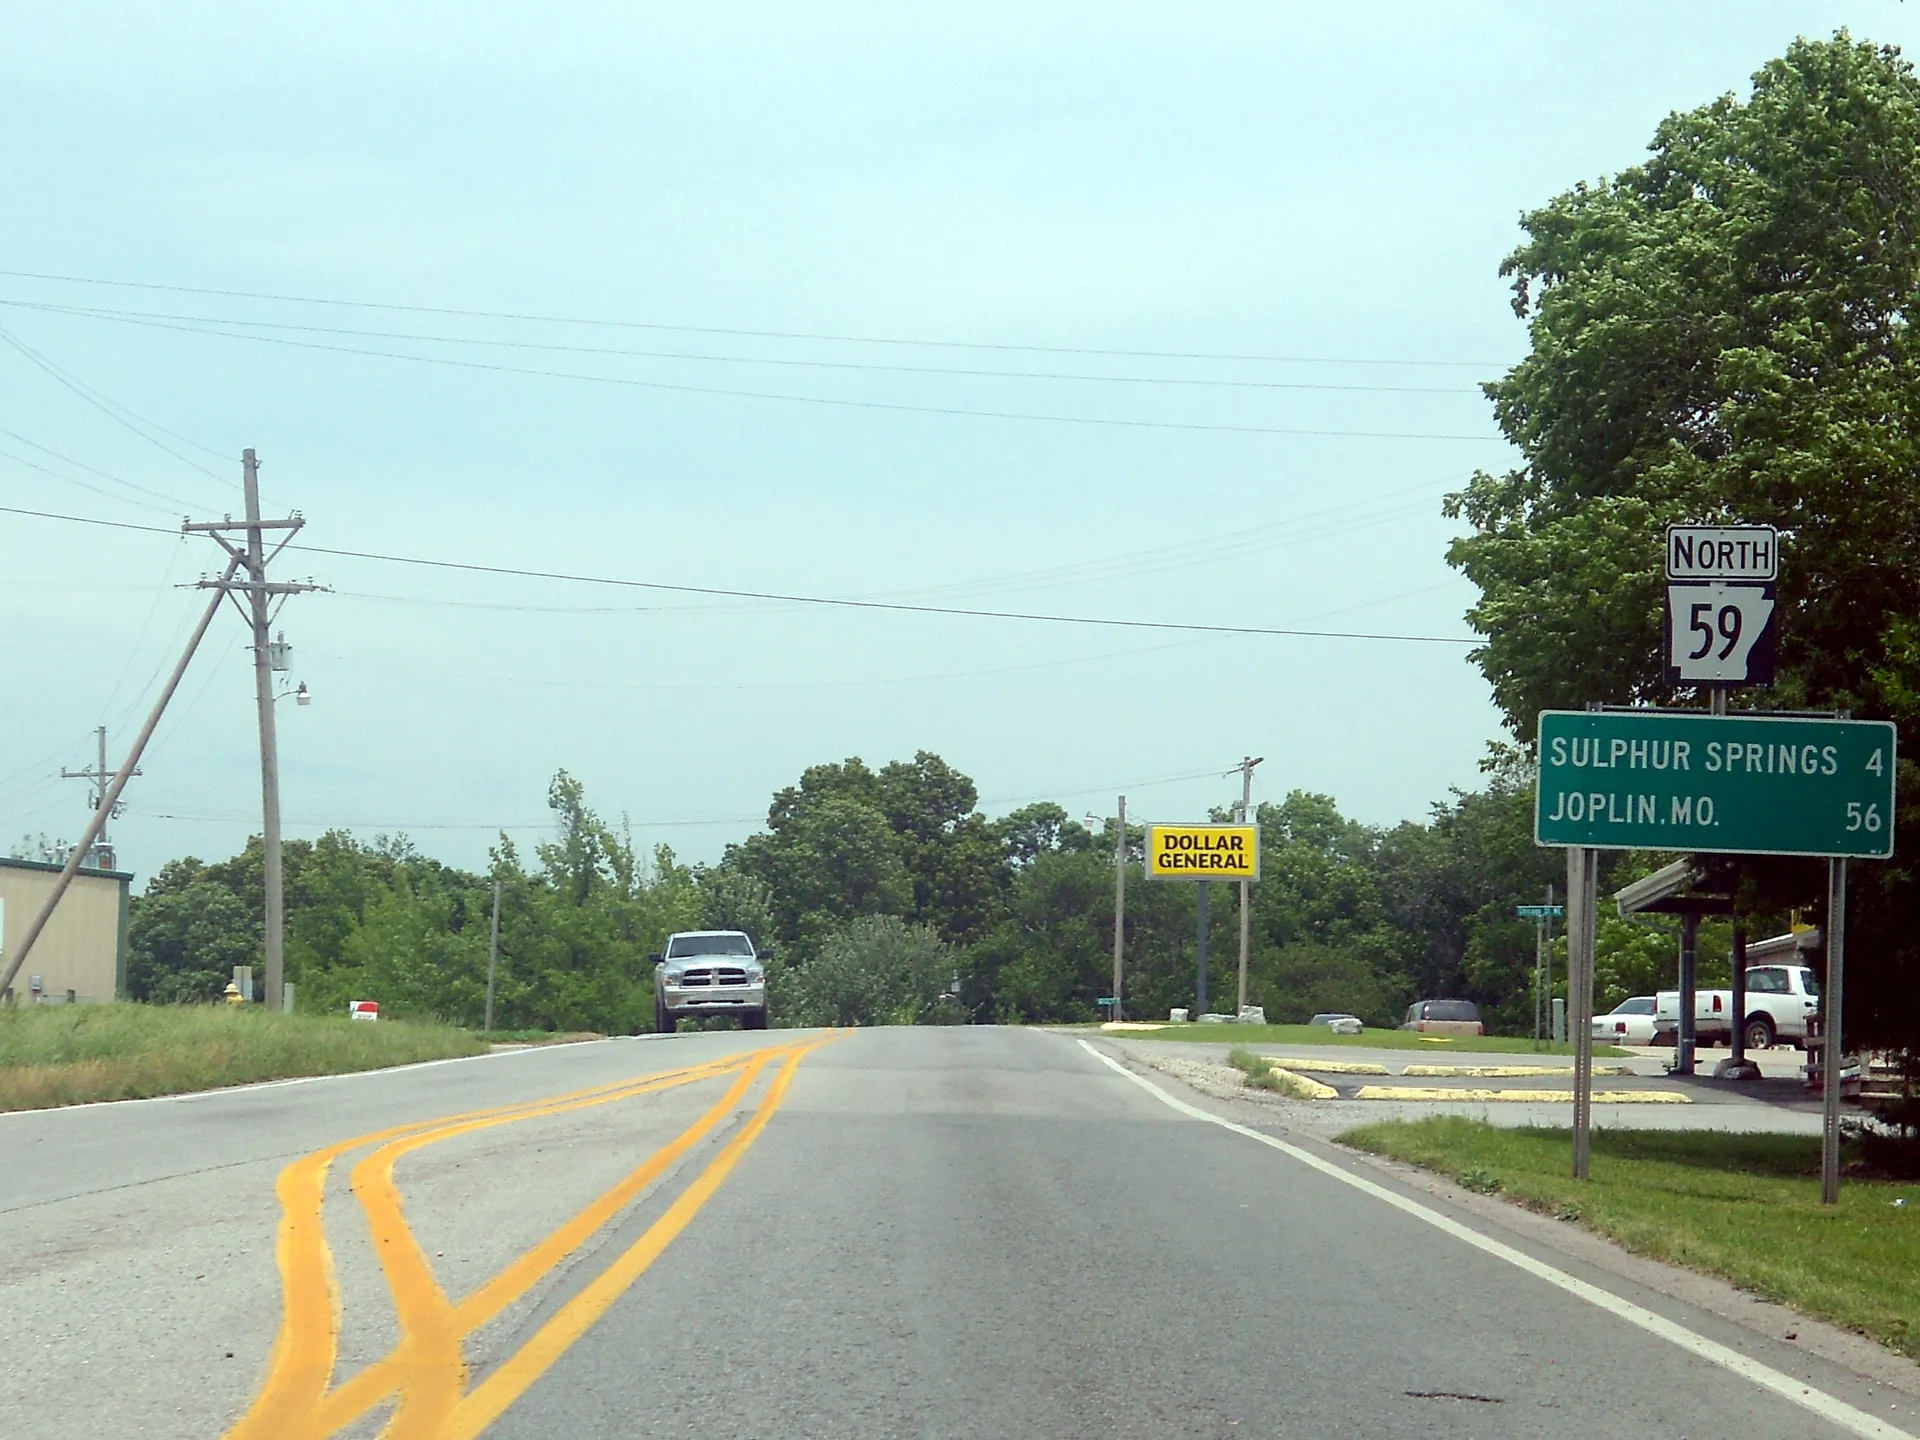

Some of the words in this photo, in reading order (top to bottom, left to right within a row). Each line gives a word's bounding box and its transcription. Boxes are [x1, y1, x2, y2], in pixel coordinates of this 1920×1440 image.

[1673, 535, 1770, 570] NORTH
[1688, 603, 1743, 661] 59
[1550, 736, 1691, 771] SULPHUR
[1705, 741, 1838, 775] SPRINGS
[1865, 747, 1884, 777] 4
[1846, 802, 1882, 832] 56
[1163, 834, 1244, 851] DOLLAR
[1158, 853, 1249, 869] GENERAL
